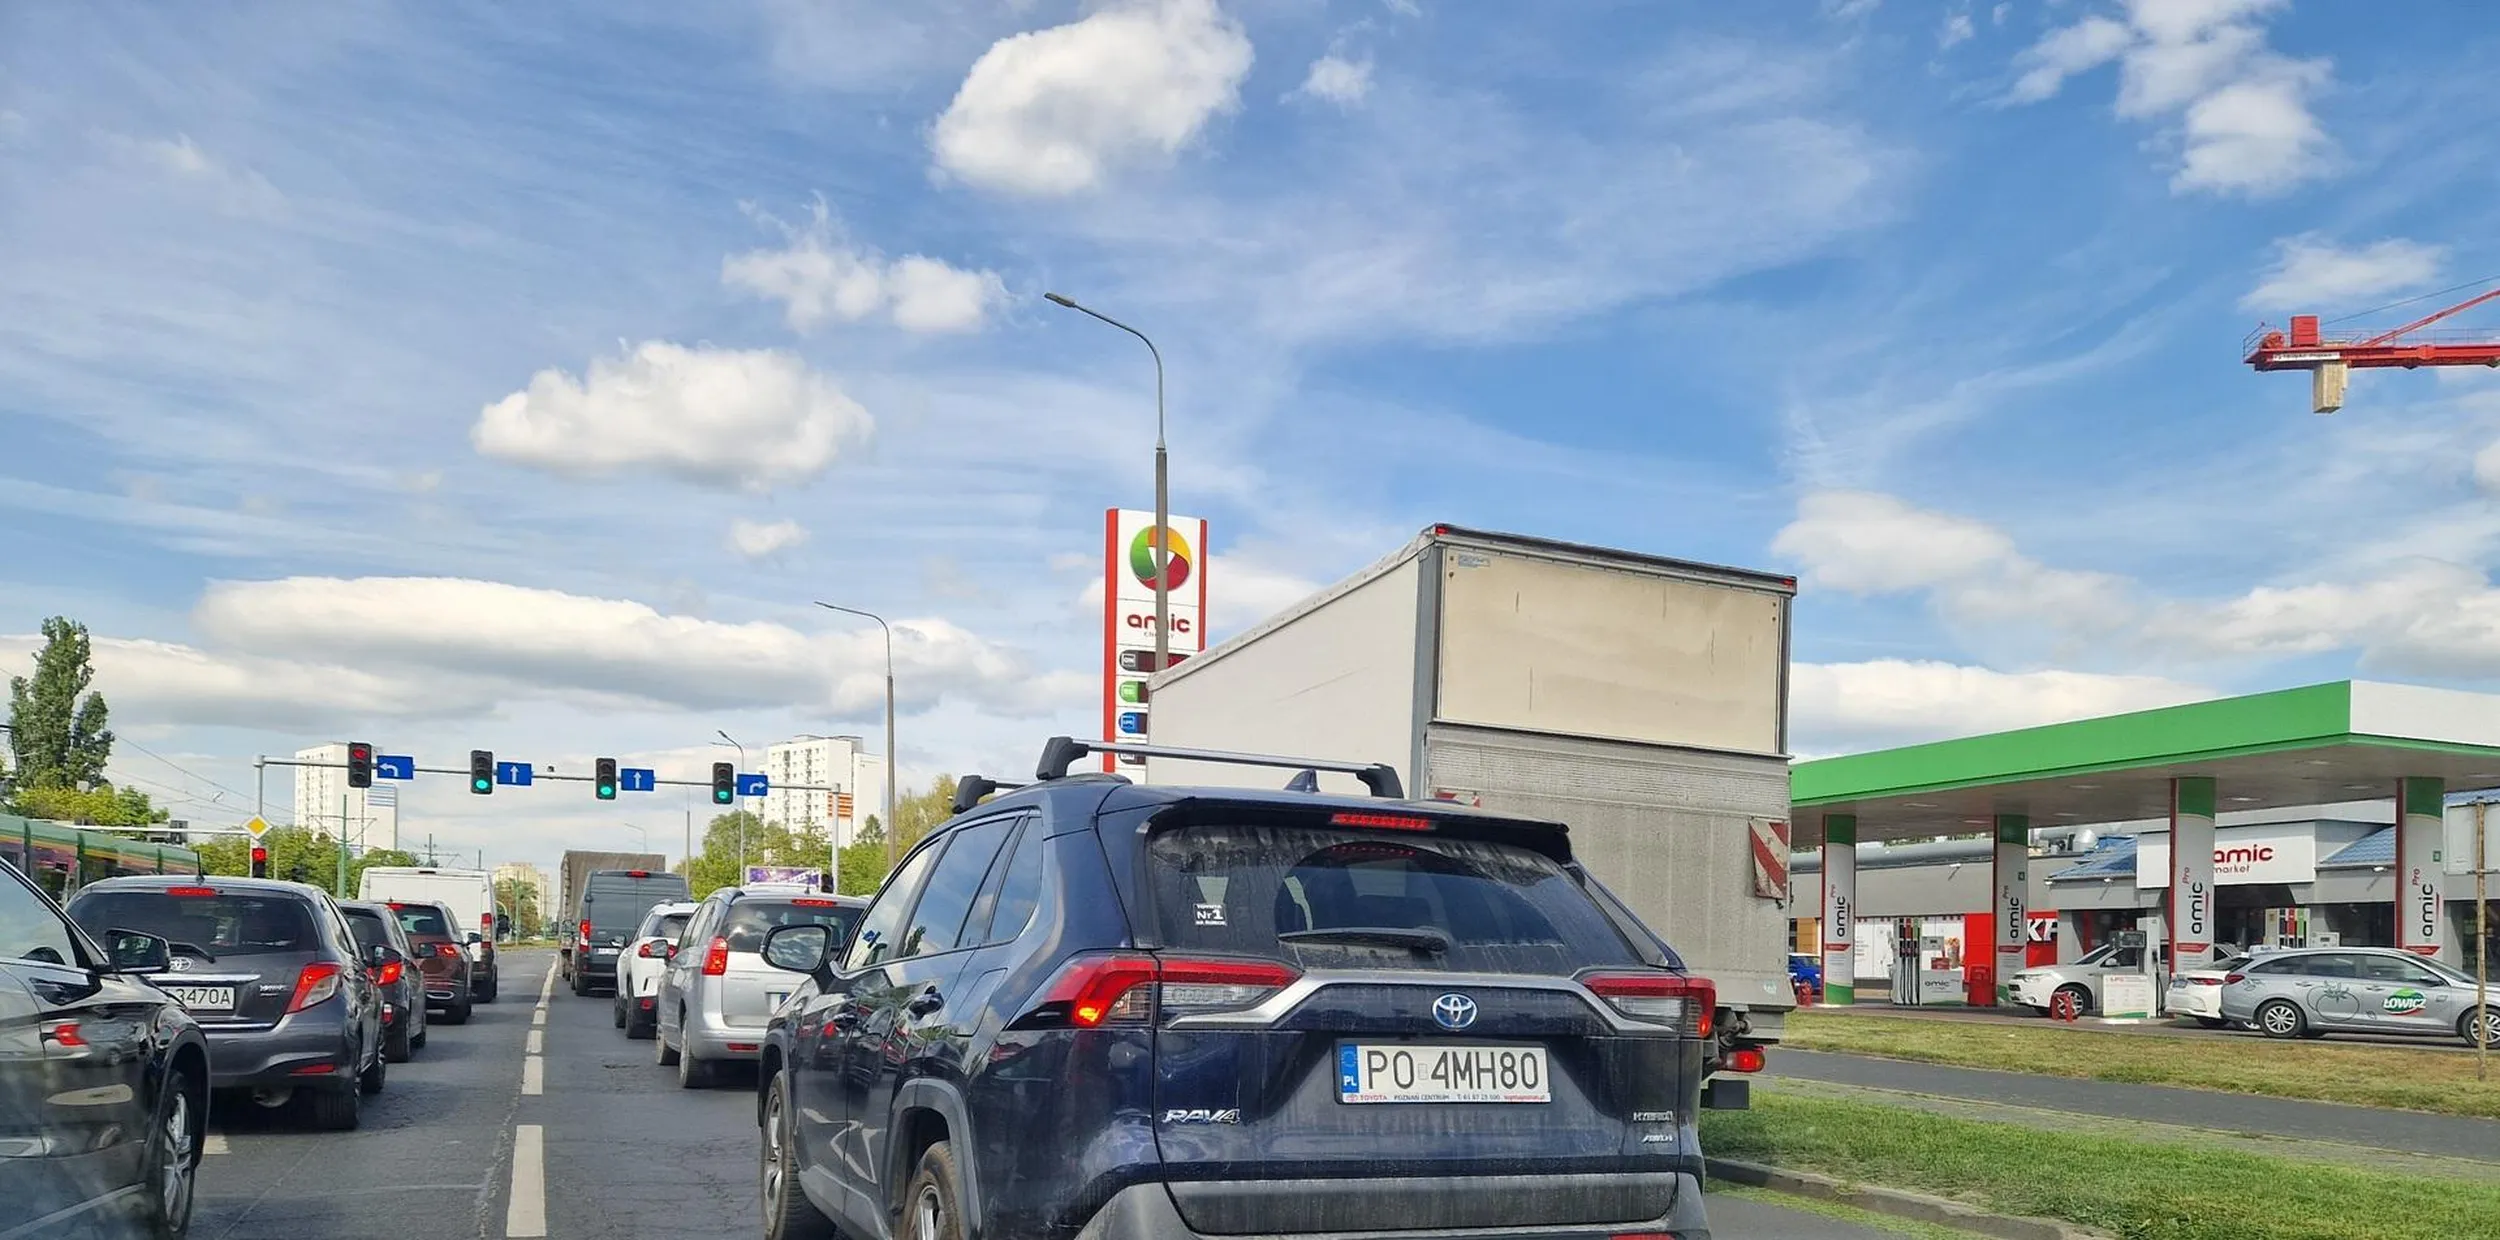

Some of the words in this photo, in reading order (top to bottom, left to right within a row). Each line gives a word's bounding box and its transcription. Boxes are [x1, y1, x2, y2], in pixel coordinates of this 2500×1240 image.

[2214, 844, 2273, 863] amic
[2412, 868, 2420, 886] Pro
[1834, 896, 1846, 938] amic
[2188, 881, 2203, 934] amic
[2418, 884, 2434, 937] amic
[2008, 897, 2020, 939] amic
[176, 988, 231, 1005] 3470A
[2383, 998, 2427, 1009] ŁOWICZ
[1366, 1050, 1415, 1090] PO
[1430, 1051, 1539, 1090] 4MH80
[1343, 1076, 1357, 1087] PL
[1162, 1108, 1241, 1123] RAV4
